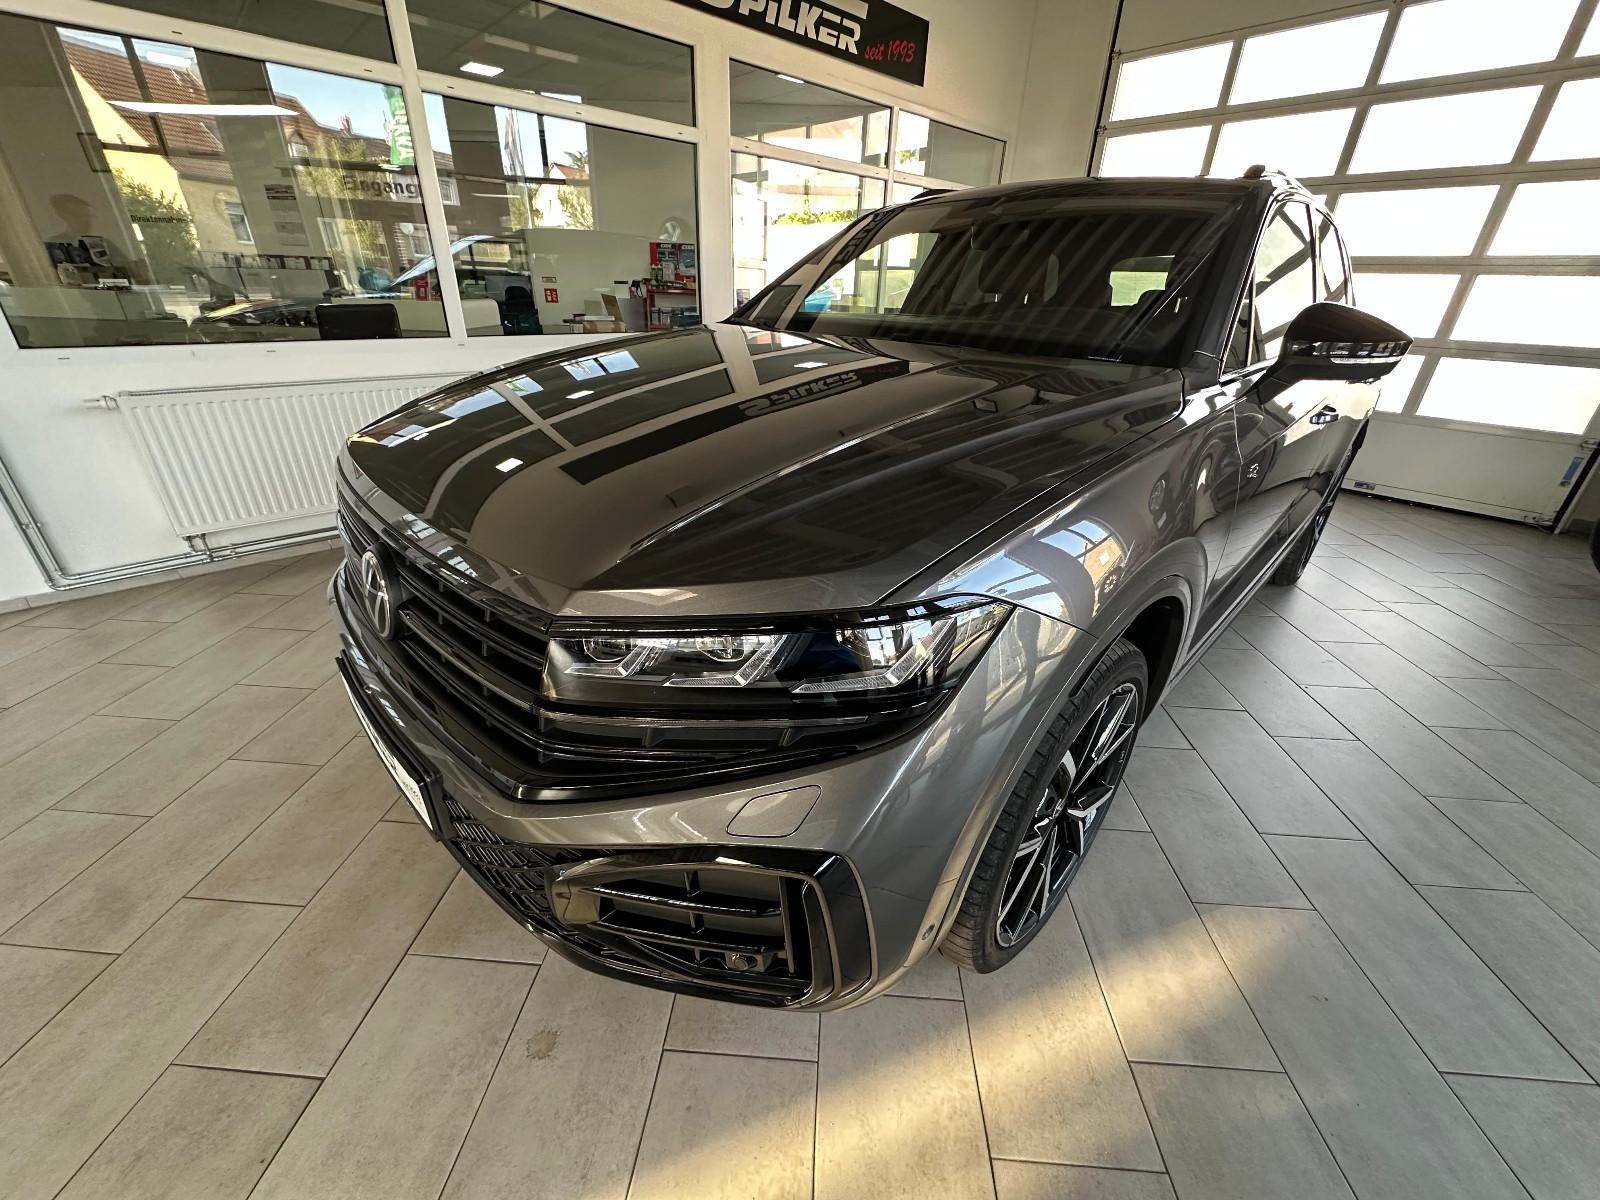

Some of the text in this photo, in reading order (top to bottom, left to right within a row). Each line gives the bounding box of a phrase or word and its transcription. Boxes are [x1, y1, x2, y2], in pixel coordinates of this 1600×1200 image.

[864, 40, 916, 63] seit 1993
[345, 176, 420, 198] Eingang
